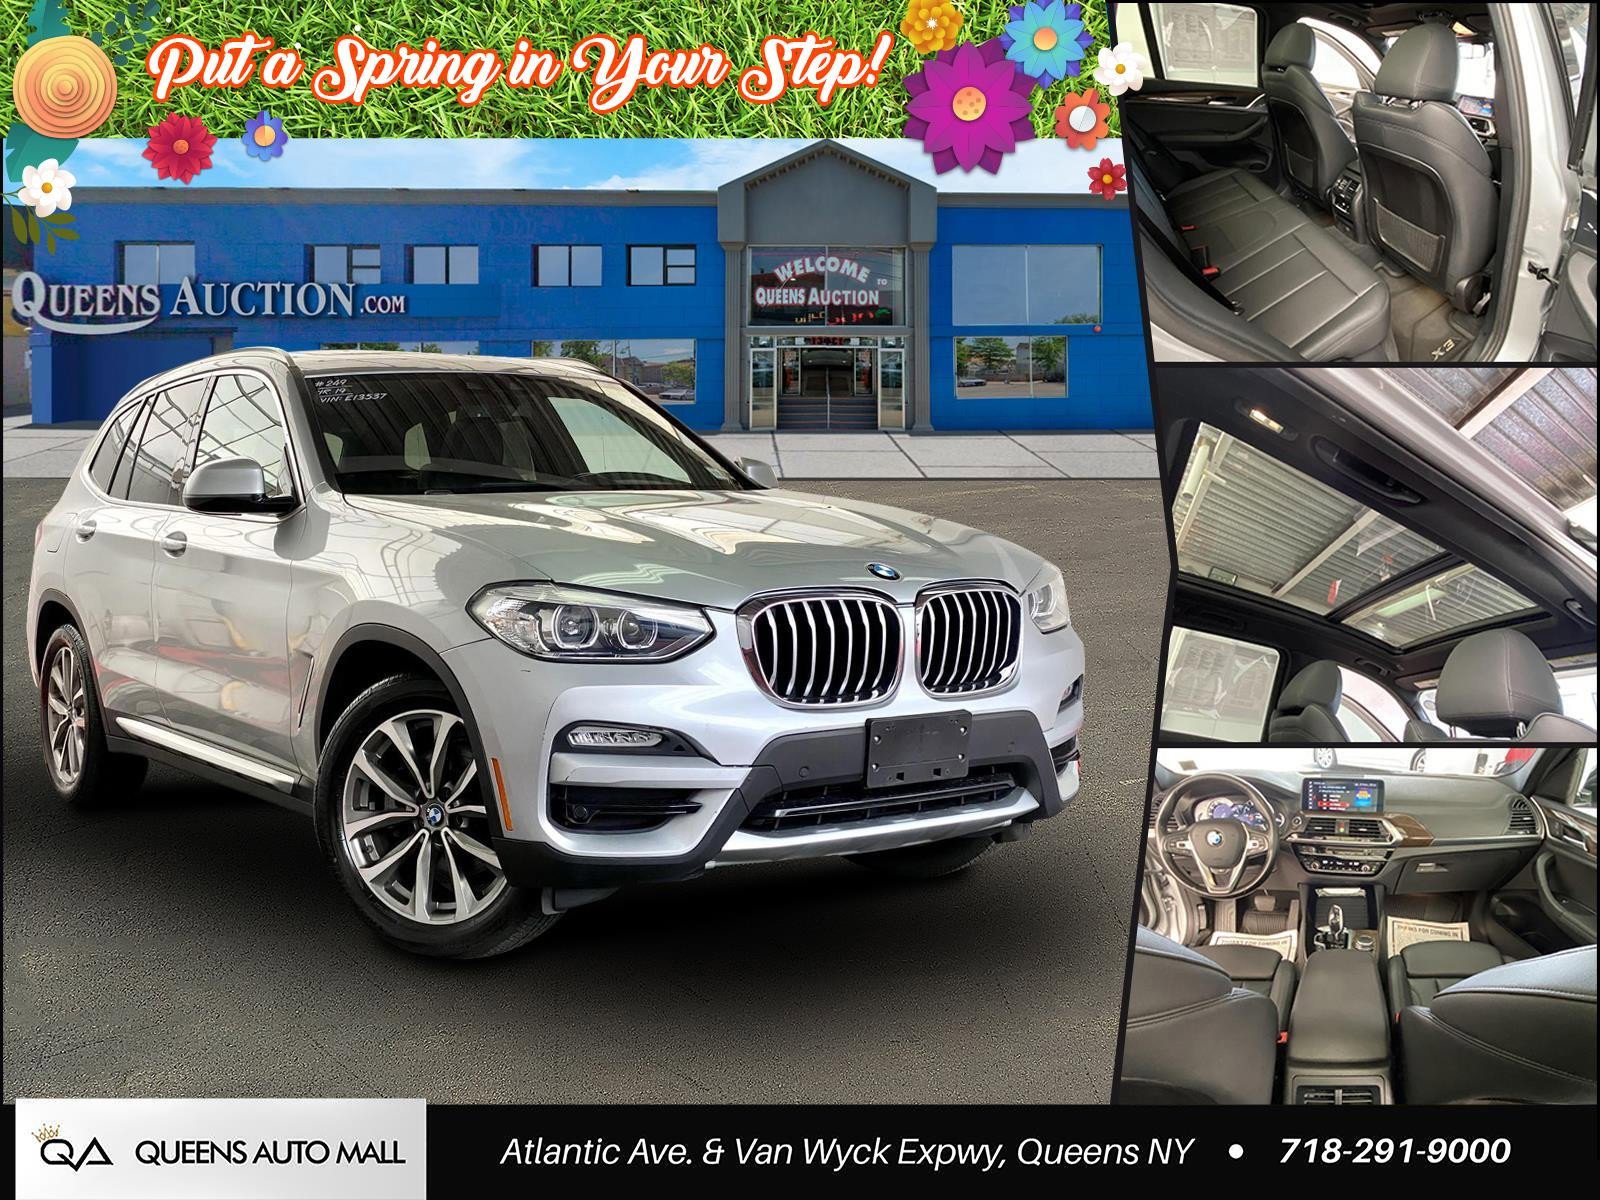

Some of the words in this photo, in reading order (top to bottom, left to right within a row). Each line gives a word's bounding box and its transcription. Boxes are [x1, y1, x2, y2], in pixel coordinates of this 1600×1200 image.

[773, 256, 871, 283] WELCOME
[877, 278, 888, 286] TO
[11, 271, 161, 335] QUEENS
[755, 287, 806, 306] QUEENS
[807, 287, 880, 306] AUCTION
